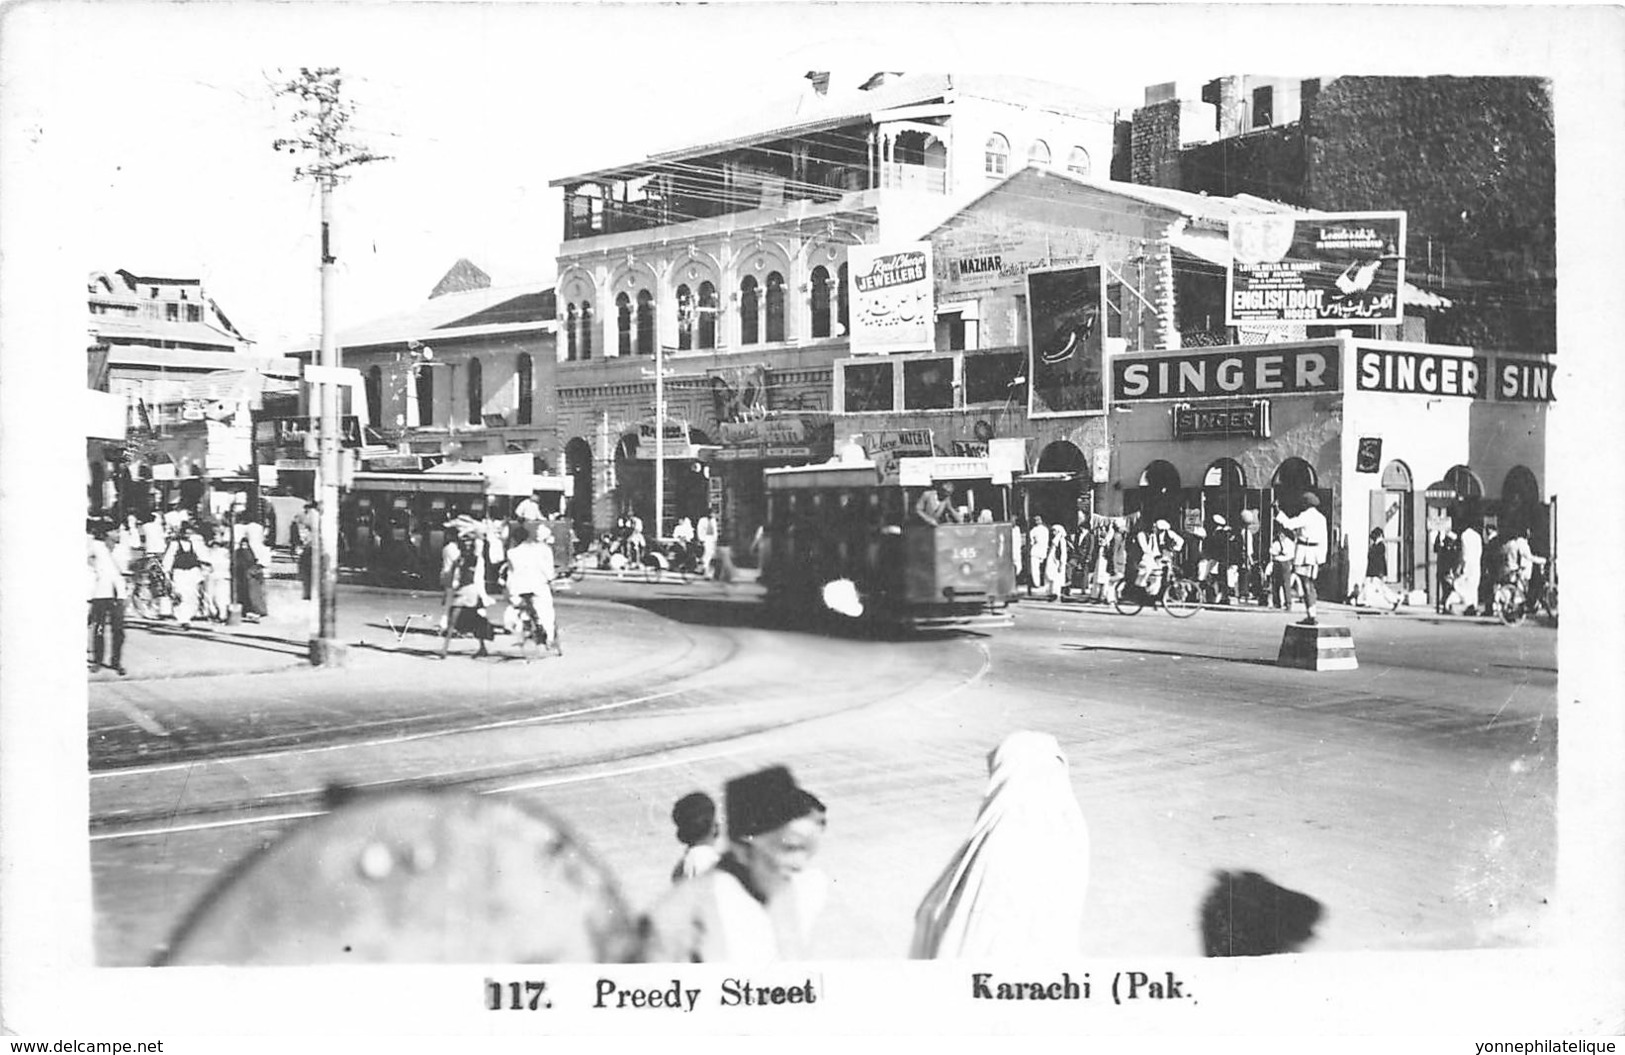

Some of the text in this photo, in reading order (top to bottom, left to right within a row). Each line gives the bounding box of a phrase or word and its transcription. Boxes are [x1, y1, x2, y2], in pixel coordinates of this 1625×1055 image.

[959, 255, 1002, 275] MAZHAR
[859, 265, 923, 292] JEWELLERS
[1234, 289, 1325, 310] ENGLISH BOOT
[1284, 308, 1318, 320] HOUSE
[1123, 353, 1327, 396] SINGER
[1361, 352, 1480, 395] SINGER
[1502, 364, 1555, 400] SIN
[1180, 412, 1254, 429] SINGER
